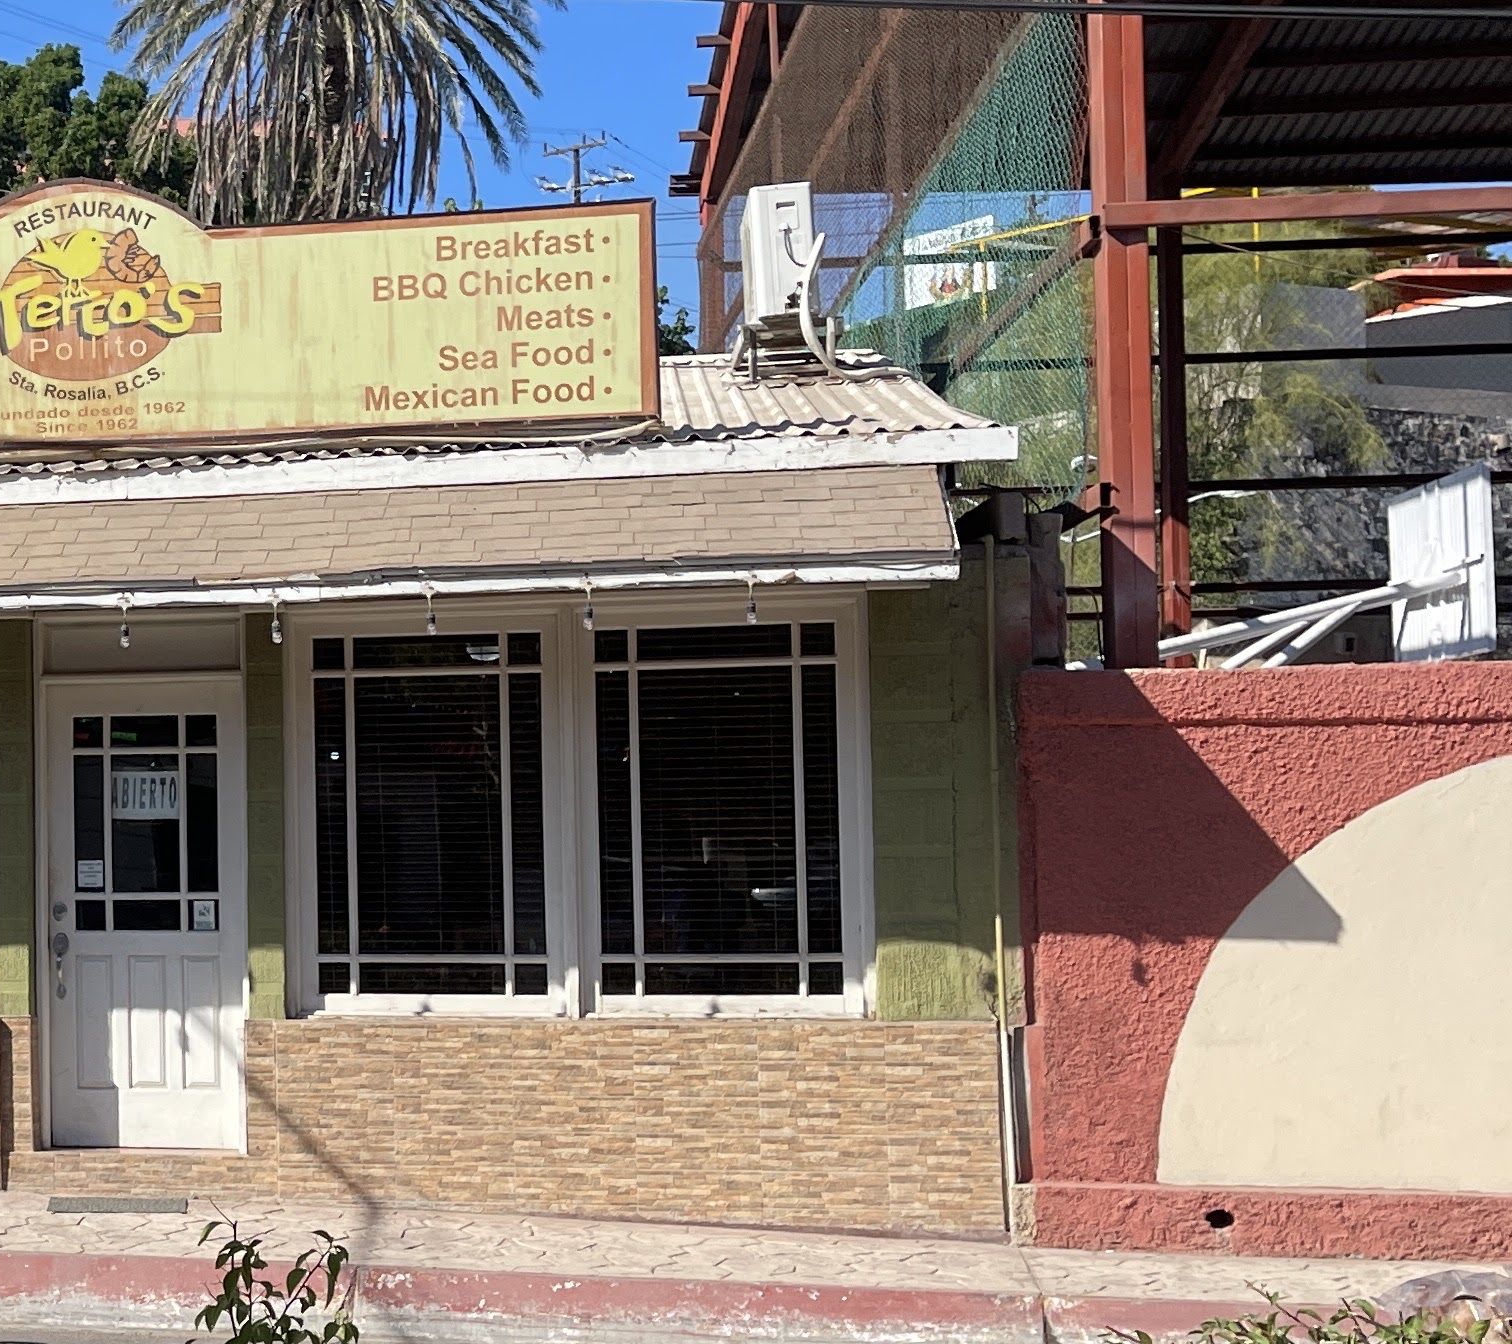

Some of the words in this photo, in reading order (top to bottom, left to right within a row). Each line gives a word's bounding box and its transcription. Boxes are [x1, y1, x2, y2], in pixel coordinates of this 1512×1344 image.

[13, 201, 157, 238] RESTAURANT
[436, 228, 594, 262] Breakfast
[372, 272, 447, 302] BBQ
[459, 267, 593, 298] Chicken
[497, 304, 594, 332] Meats
[29, 336, 148, 362] Pollito
[439, 344, 498, 372] Sea
[511, 338, 595, 367] Food
[8, 370, 38, 395] Sta.
[115, 366, 166, 397] B.C.S.
[364, 384, 498, 413] Mexican
[512, 376, 595, 405] Food
[37, 421, 88, 434] Since
[97, 418, 139, 432] 1962
[78, 404, 136, 419] desde
[143, 401, 187, 416] 1962
[111, 776, 177, 809] ABIERTO
